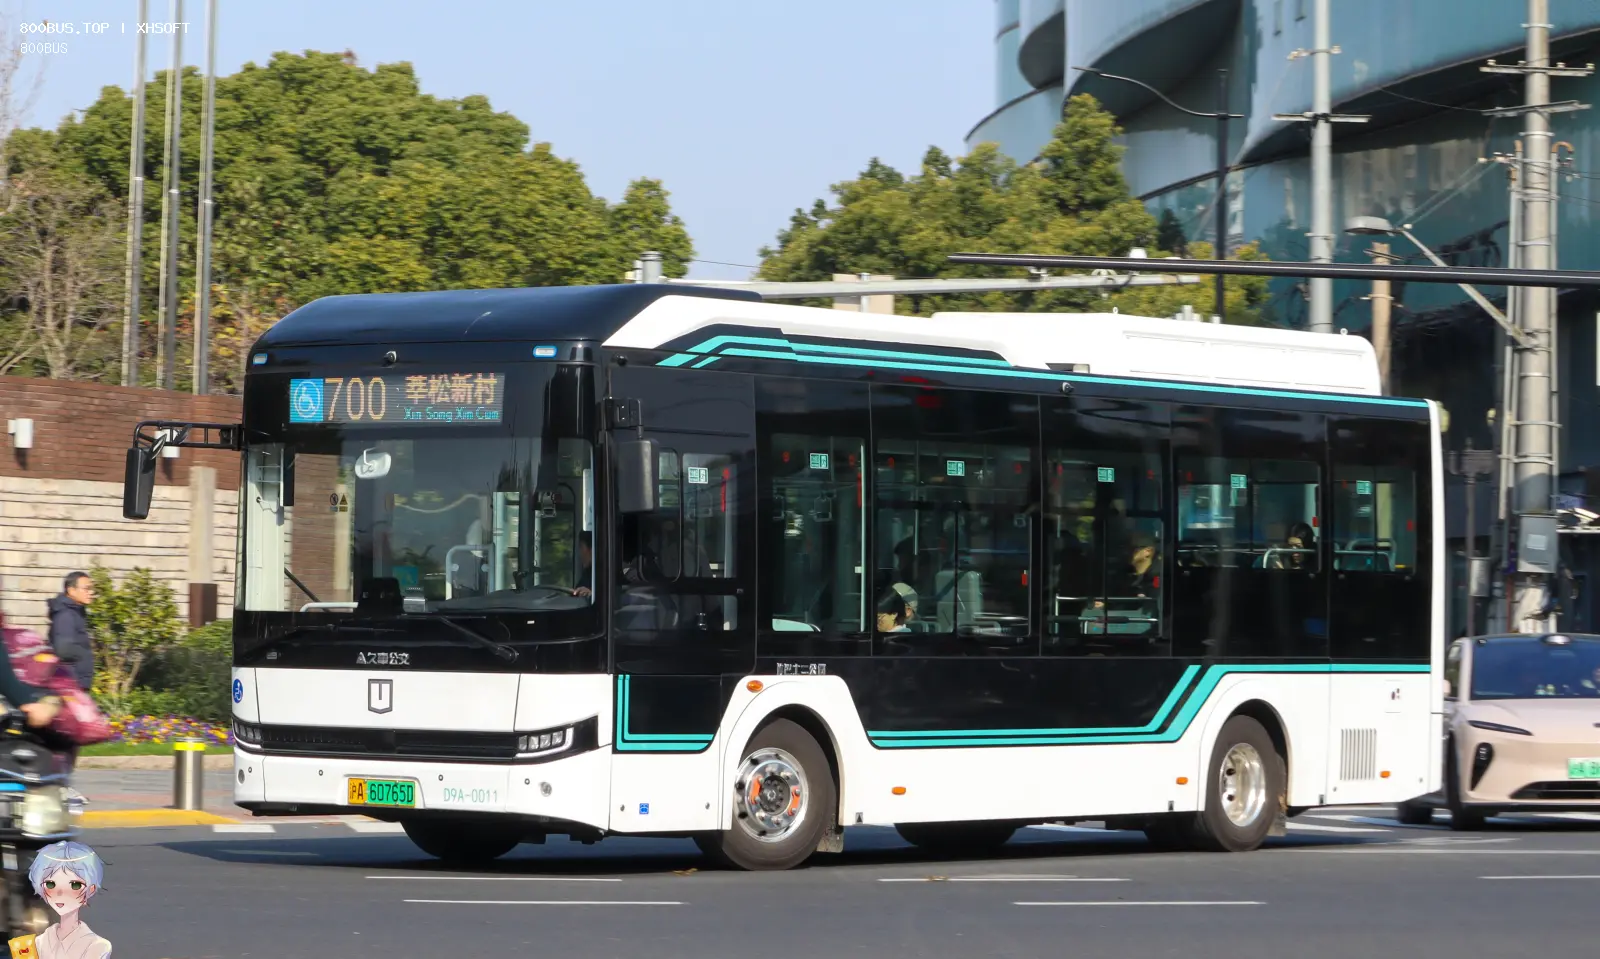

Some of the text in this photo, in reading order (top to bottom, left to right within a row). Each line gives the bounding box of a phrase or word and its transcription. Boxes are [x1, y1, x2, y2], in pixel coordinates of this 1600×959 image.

[325, 377, 386, 421] 700
[405, 372, 498, 405] 莘松新村
[443, 787, 498, 803] D9A-0011
